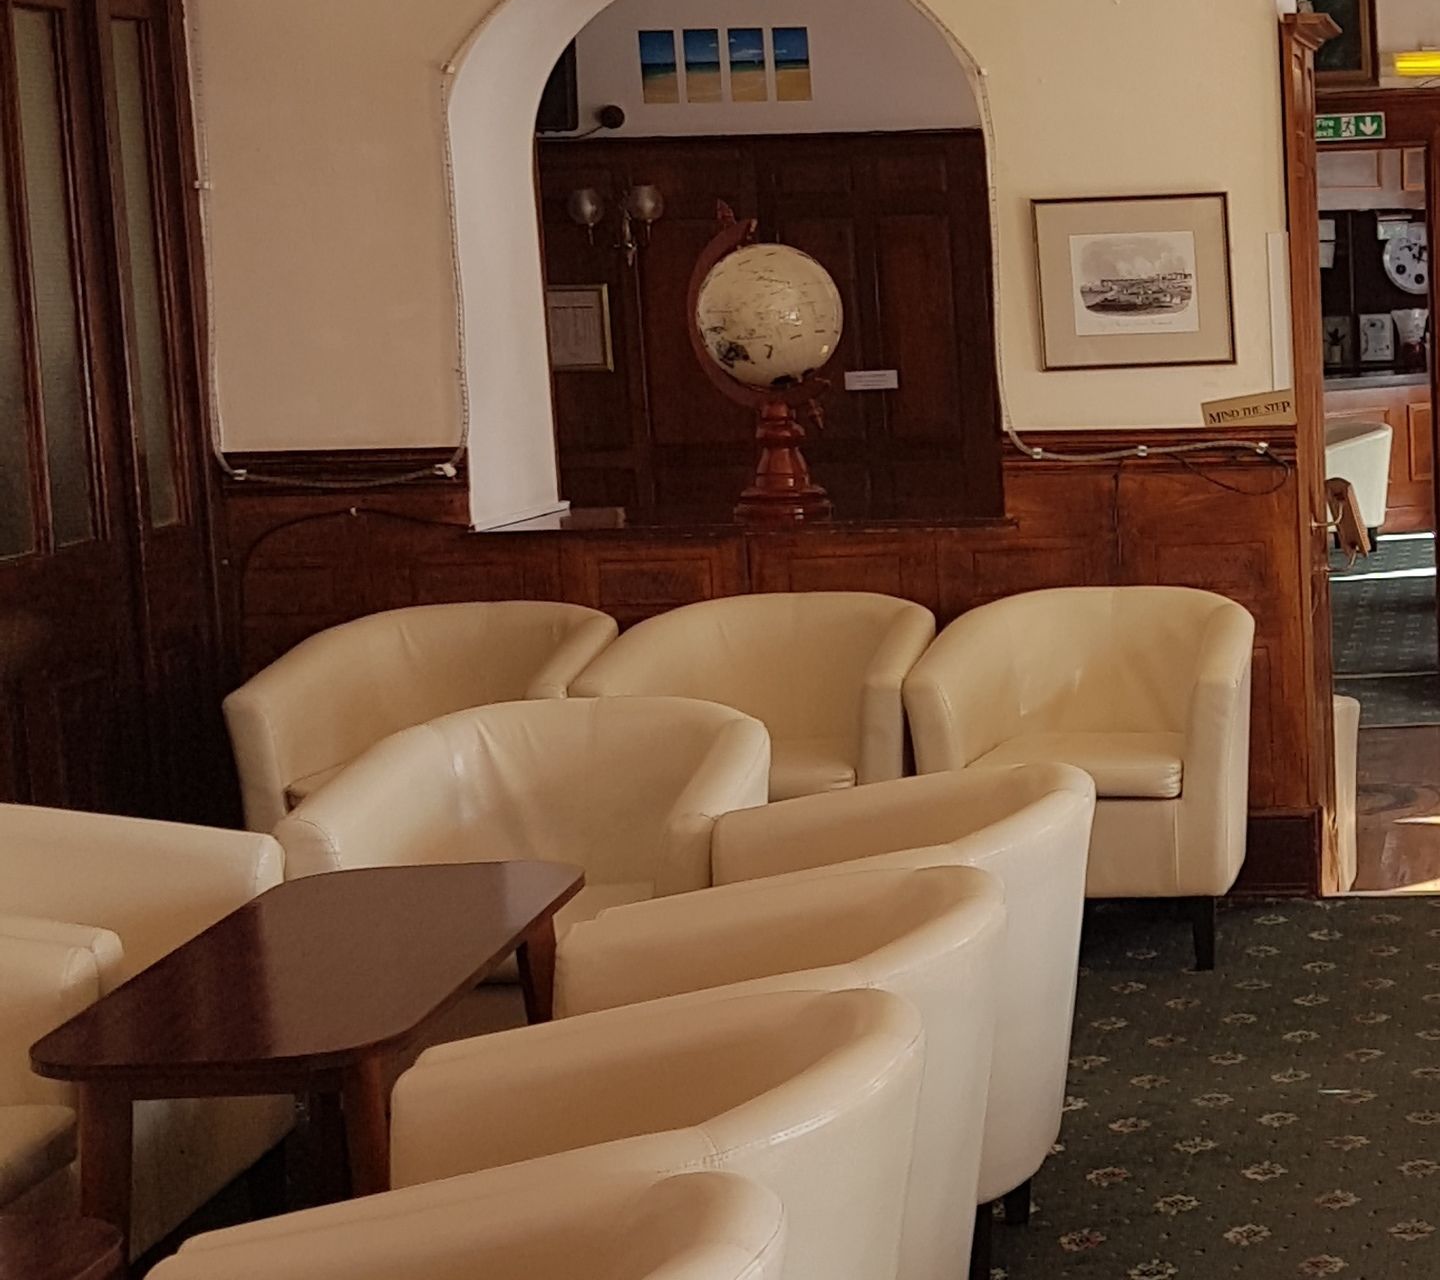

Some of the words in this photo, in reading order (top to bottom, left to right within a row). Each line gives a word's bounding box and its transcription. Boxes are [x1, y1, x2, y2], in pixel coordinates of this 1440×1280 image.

[1208, 409, 1240, 425] MIND
[1242, 405, 1262, 417] THE
[1264, 400, 1291, 413] STEP
